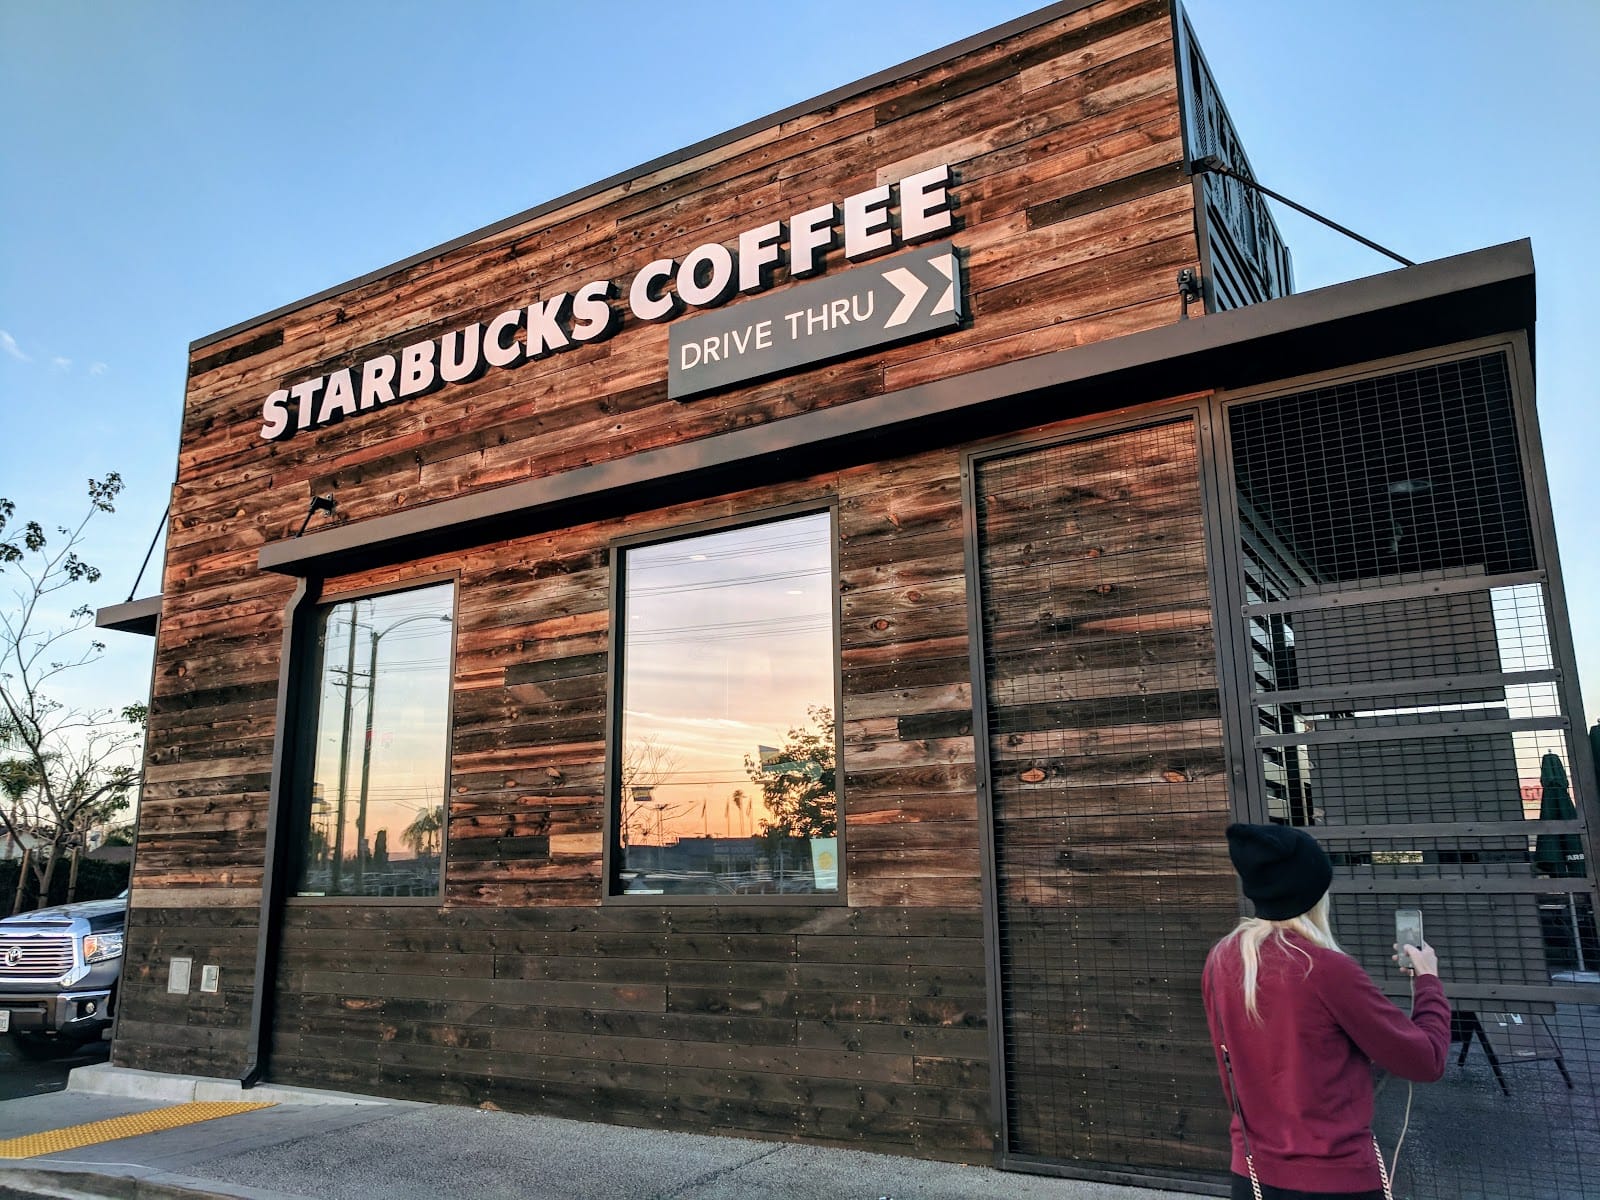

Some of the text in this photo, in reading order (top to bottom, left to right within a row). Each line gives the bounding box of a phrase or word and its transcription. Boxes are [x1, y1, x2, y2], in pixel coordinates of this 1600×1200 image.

[260, 164, 951, 440] STARBUCKS COFFEE
[681, 291, 874, 371] DRIVE THRU
